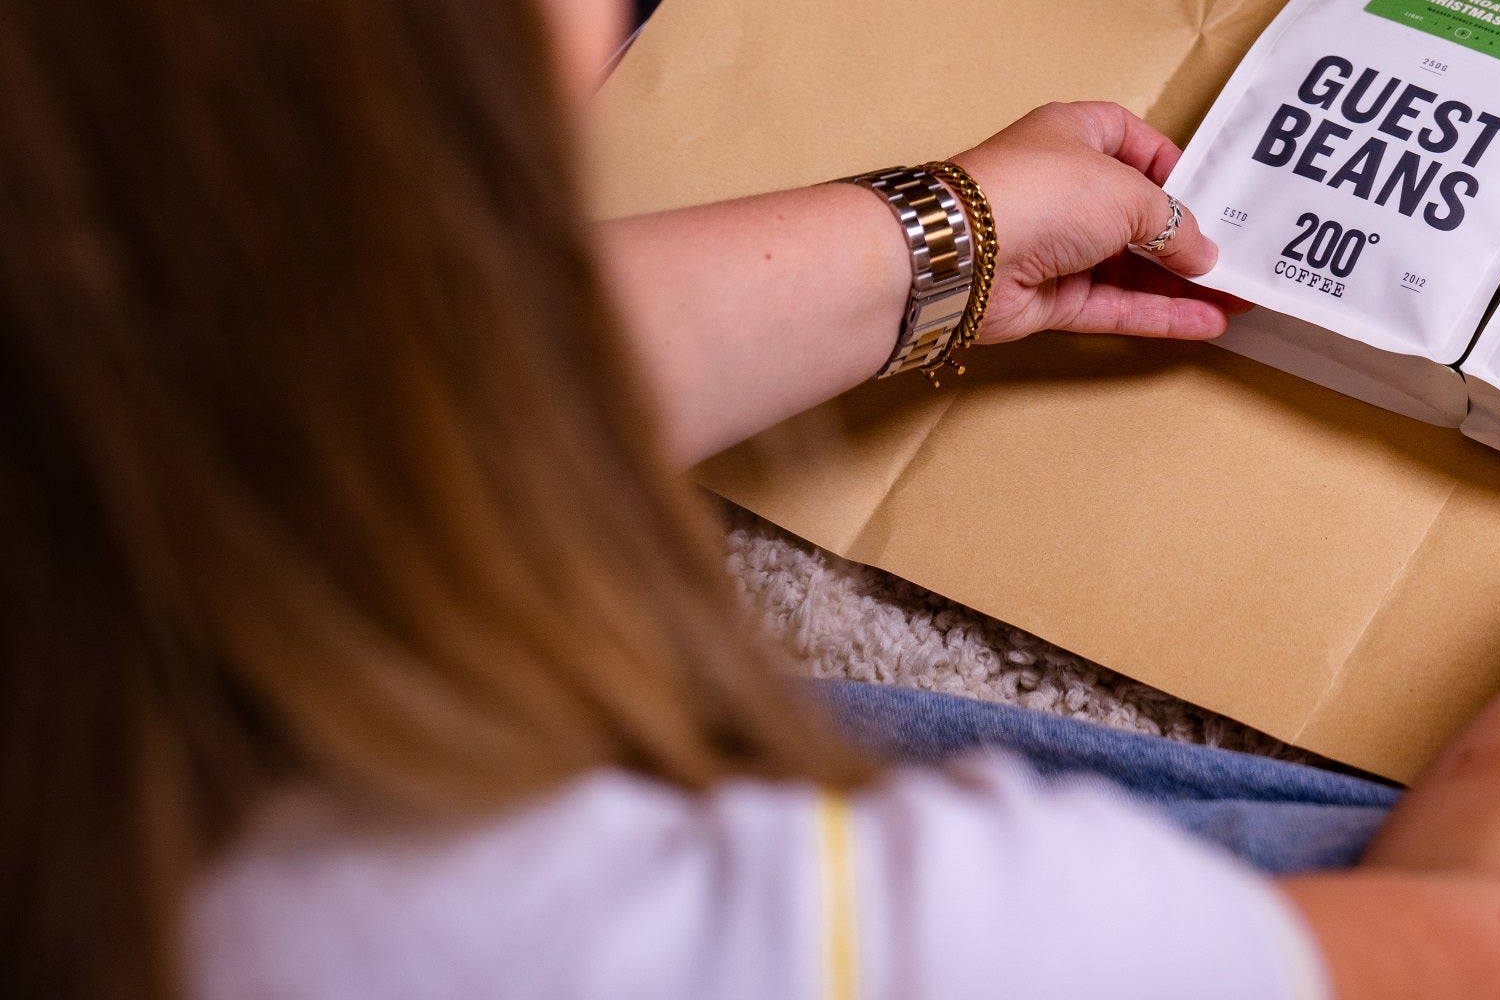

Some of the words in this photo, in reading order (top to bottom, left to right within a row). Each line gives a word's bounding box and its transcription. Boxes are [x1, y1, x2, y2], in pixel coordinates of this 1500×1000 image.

[1422, 57, 1449, 73] 250G
[1251, 103, 1480, 232] BEANS
[1223, 206, 1249, 223] ESTD
[1280, 212, 1381, 279] 200°
[1274, 260, 1346, 299] COFFEE
[1402, 272, 1426, 288] 2012
